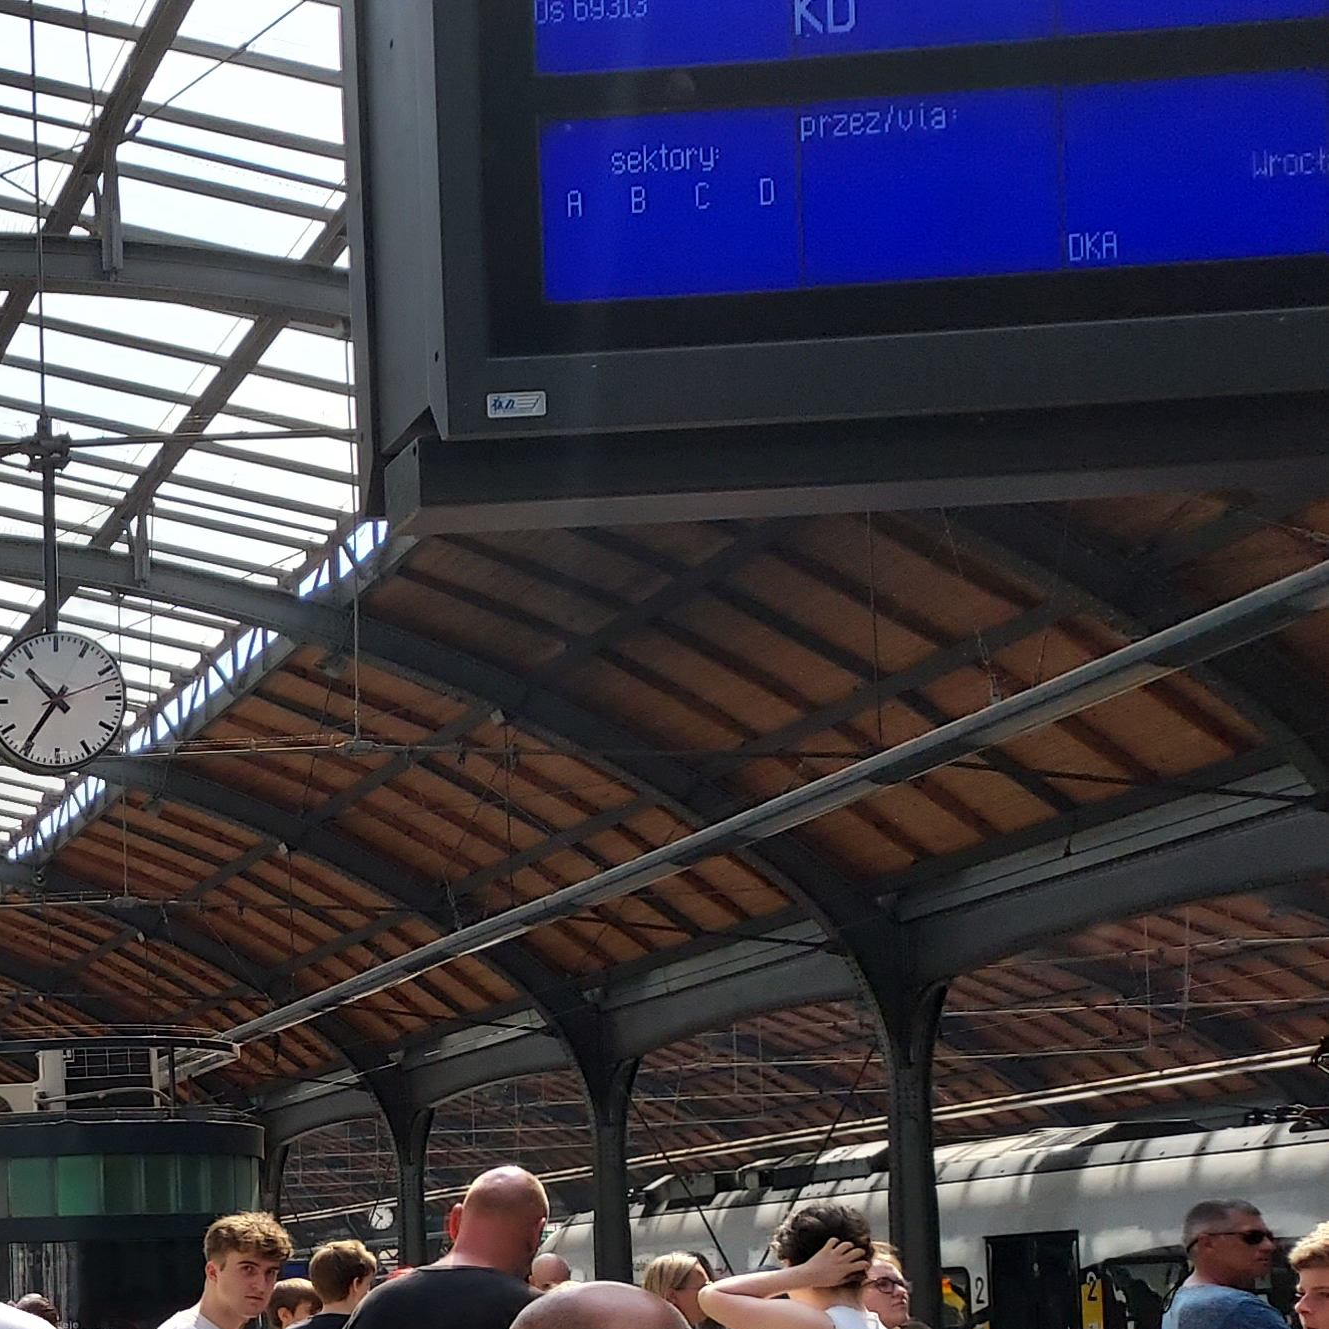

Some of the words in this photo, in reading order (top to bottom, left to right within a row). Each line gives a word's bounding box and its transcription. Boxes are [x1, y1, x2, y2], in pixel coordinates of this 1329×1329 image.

[800, 102, 957, 142] przez/via:
[611, 144, 720, 175] sektory:
[567, 189, 583, 218] A
[630, 186, 646, 214] B
[694, 182, 711, 210] C
[759, 177, 775, 206] D
[1068, 231, 1118, 262] DKA
[975, 1276, 985, 1304] 2
[1085, 1271, 1098, 1301] 2
